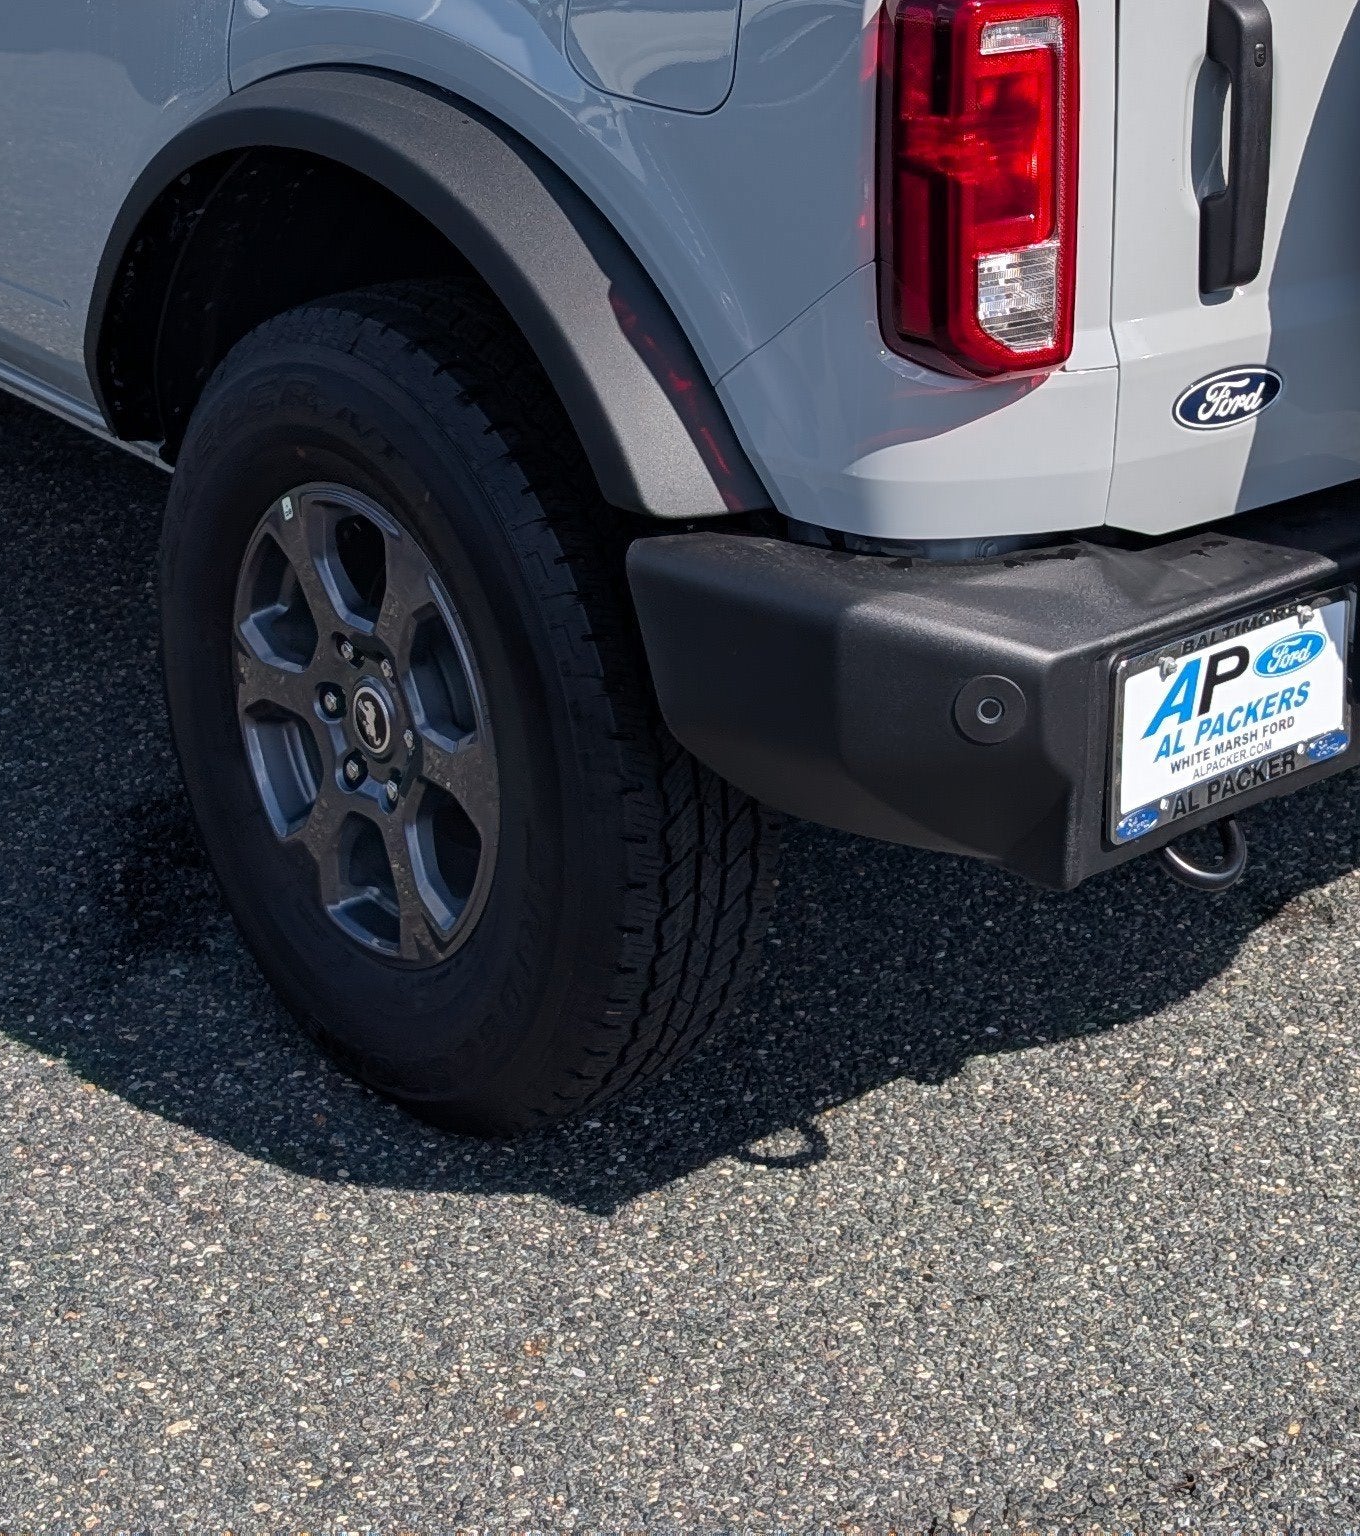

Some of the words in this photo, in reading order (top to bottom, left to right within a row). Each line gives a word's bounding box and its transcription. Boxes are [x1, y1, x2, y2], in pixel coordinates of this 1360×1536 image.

[1198, 378, 1266, 421] Ford
[1266, 637, 1313, 674] Ford
[1141, 645, 1250, 740] AP
[1153, 728, 1186, 764] AL
[1194, 681, 1311, 746] PACKERS
[1170, 747, 1211, 774] WHITE
[1214, 729, 1258, 756] MARSH
[1262, 715, 1296, 738] FORD
[1171, 793, 1200, 819] AL
[1207, 749, 1296, 805] PACKER
[1192, 739, 1273, 780] ALPACKER.COM
